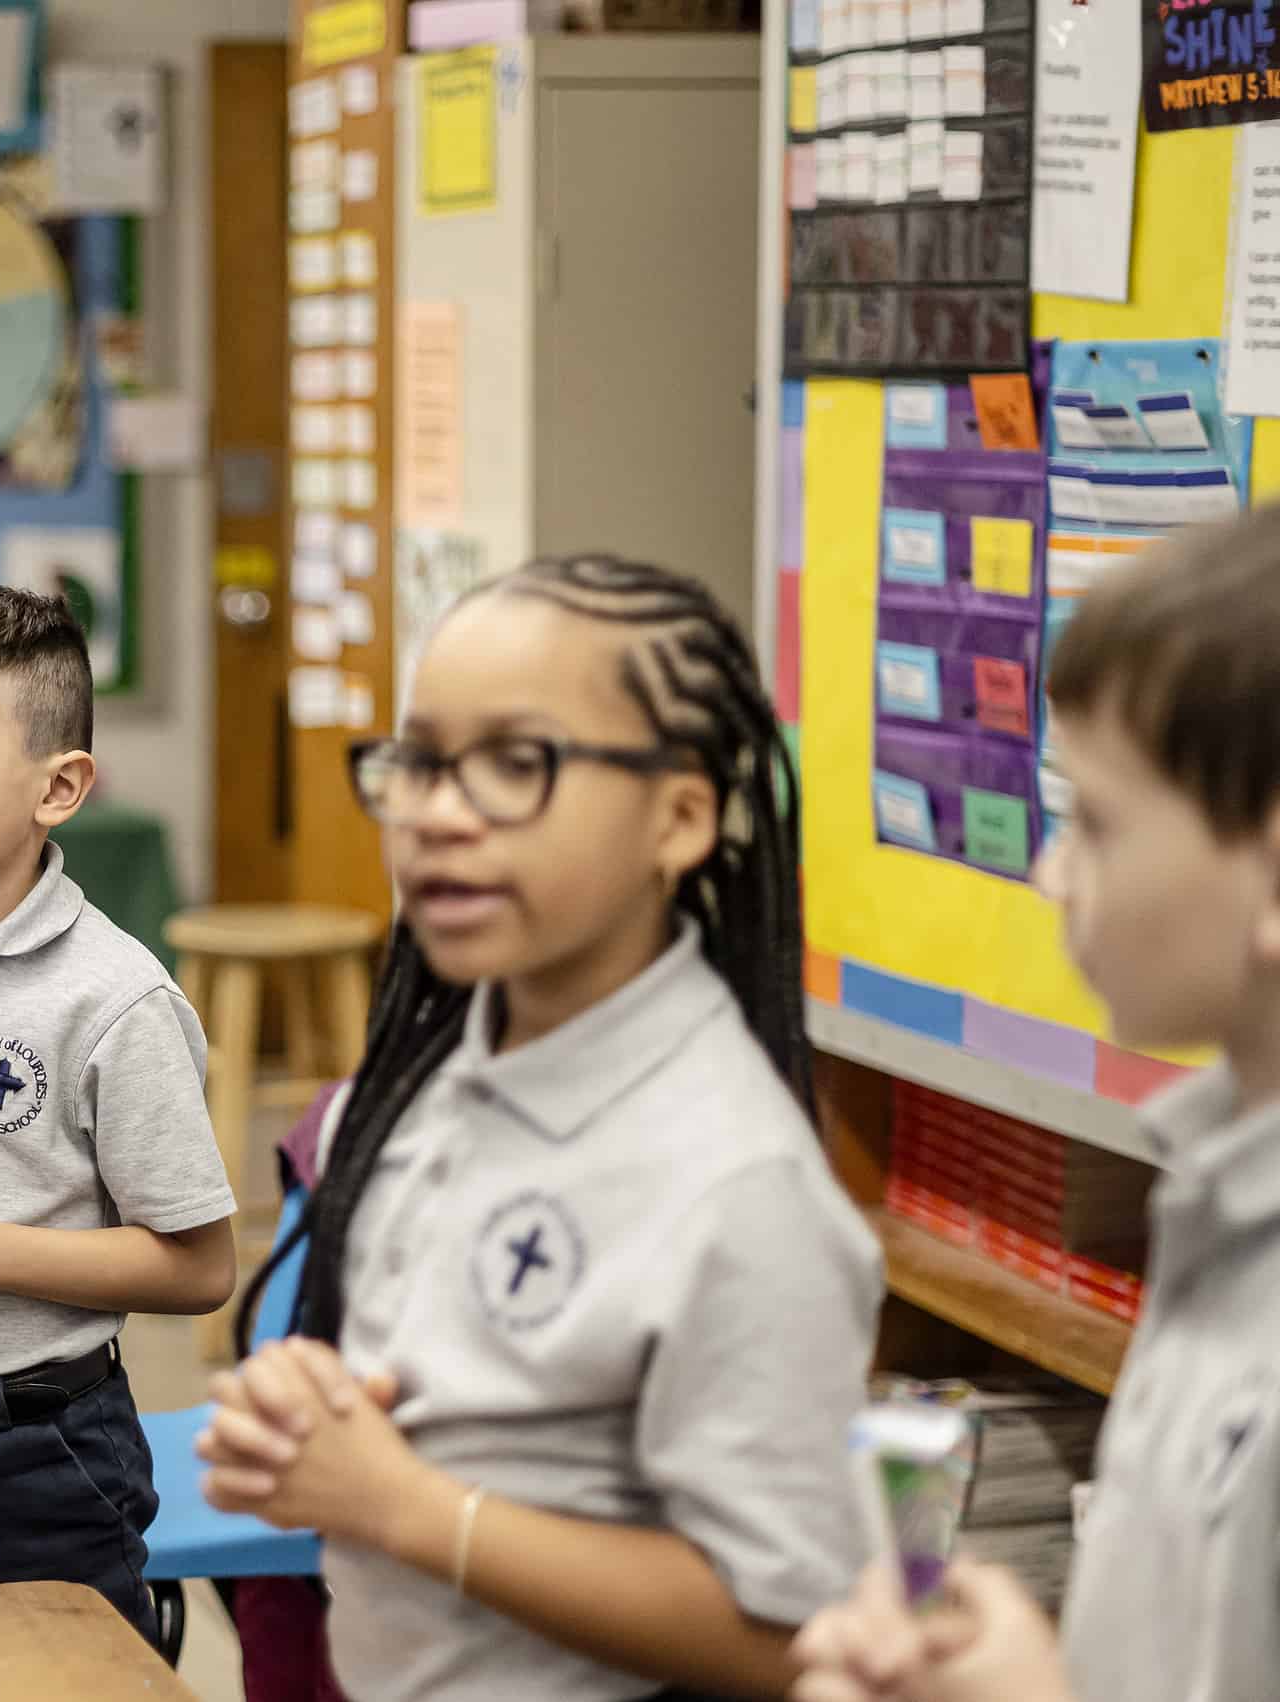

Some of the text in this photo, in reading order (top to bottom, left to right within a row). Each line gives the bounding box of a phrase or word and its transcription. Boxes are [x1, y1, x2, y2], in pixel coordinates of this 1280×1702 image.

[1163, 0, 1276, 72] SHINE
[1159, 73, 1243, 112] MATTHEW
[4, 1039, 19, 1051] of
[16, 1043, 48, 1099] LOURDES
